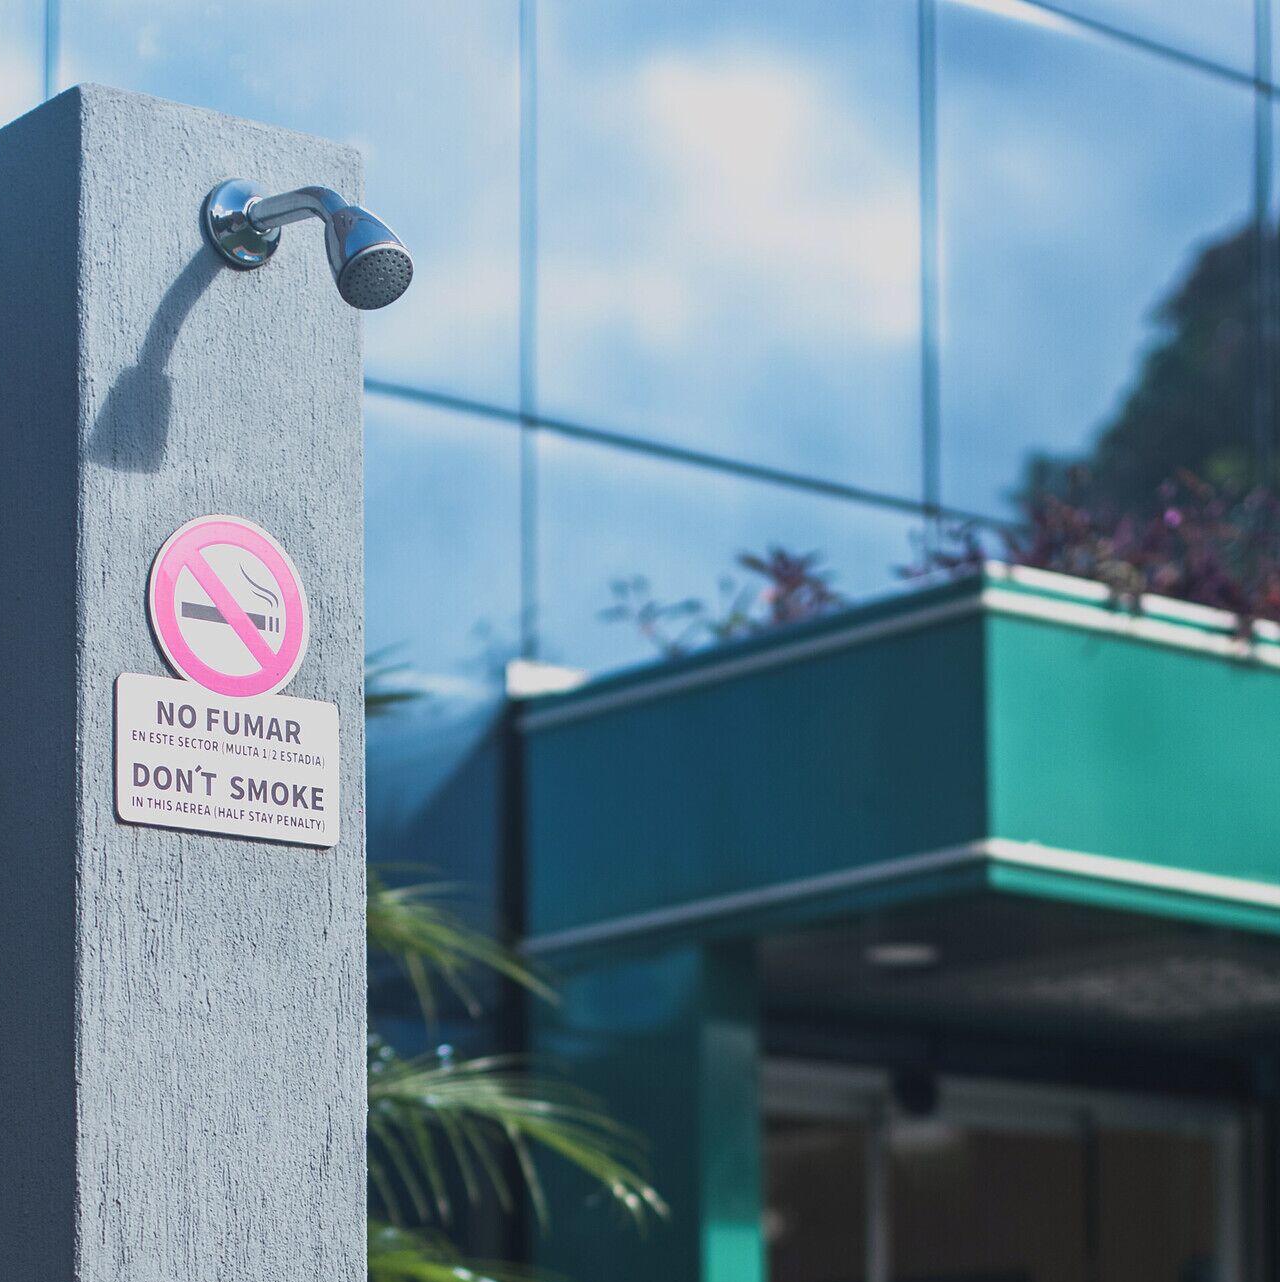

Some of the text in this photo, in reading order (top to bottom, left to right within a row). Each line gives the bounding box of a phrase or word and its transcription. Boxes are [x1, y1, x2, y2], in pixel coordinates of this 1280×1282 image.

[157, 701, 301, 745] NO FUMAR
[132, 730, 146, 742] EN
[149, 732, 175, 746] ESTE
[178, 736, 219, 751] SECTOR
[222, 742, 259, 757] (MULTA
[281, 751, 325, 769] ESTADIA)
[230, 776, 324, 811] SMOKE
[132, 796, 325, 833] IN THIS AEREA (HALF STAY PENALTY)
